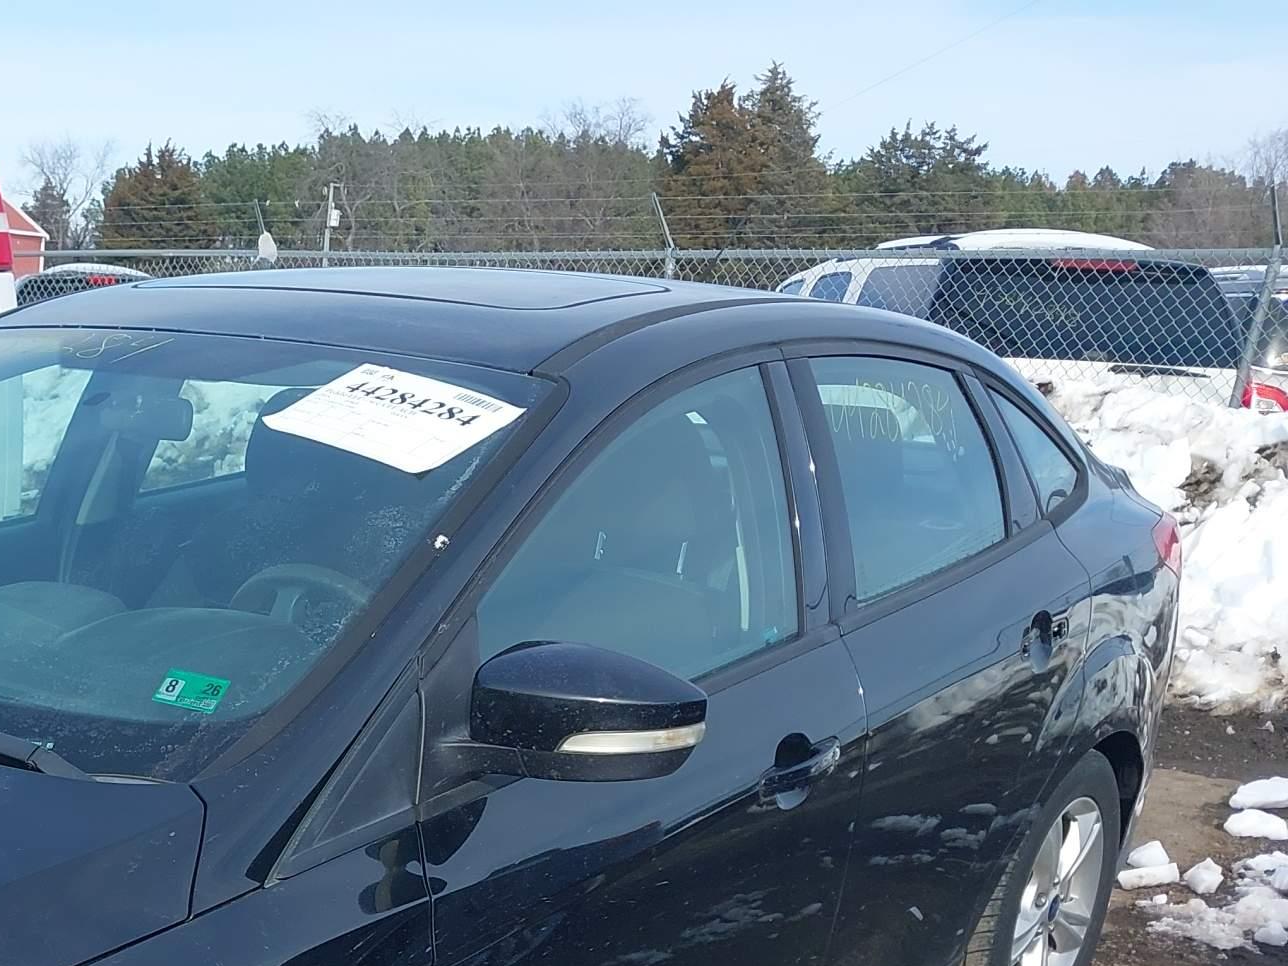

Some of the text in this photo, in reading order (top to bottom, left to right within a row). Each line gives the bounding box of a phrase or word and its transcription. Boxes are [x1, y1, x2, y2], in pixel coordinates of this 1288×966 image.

[345, 382, 481, 426] 44284284
[165, 679, 222, 697] 8 26
